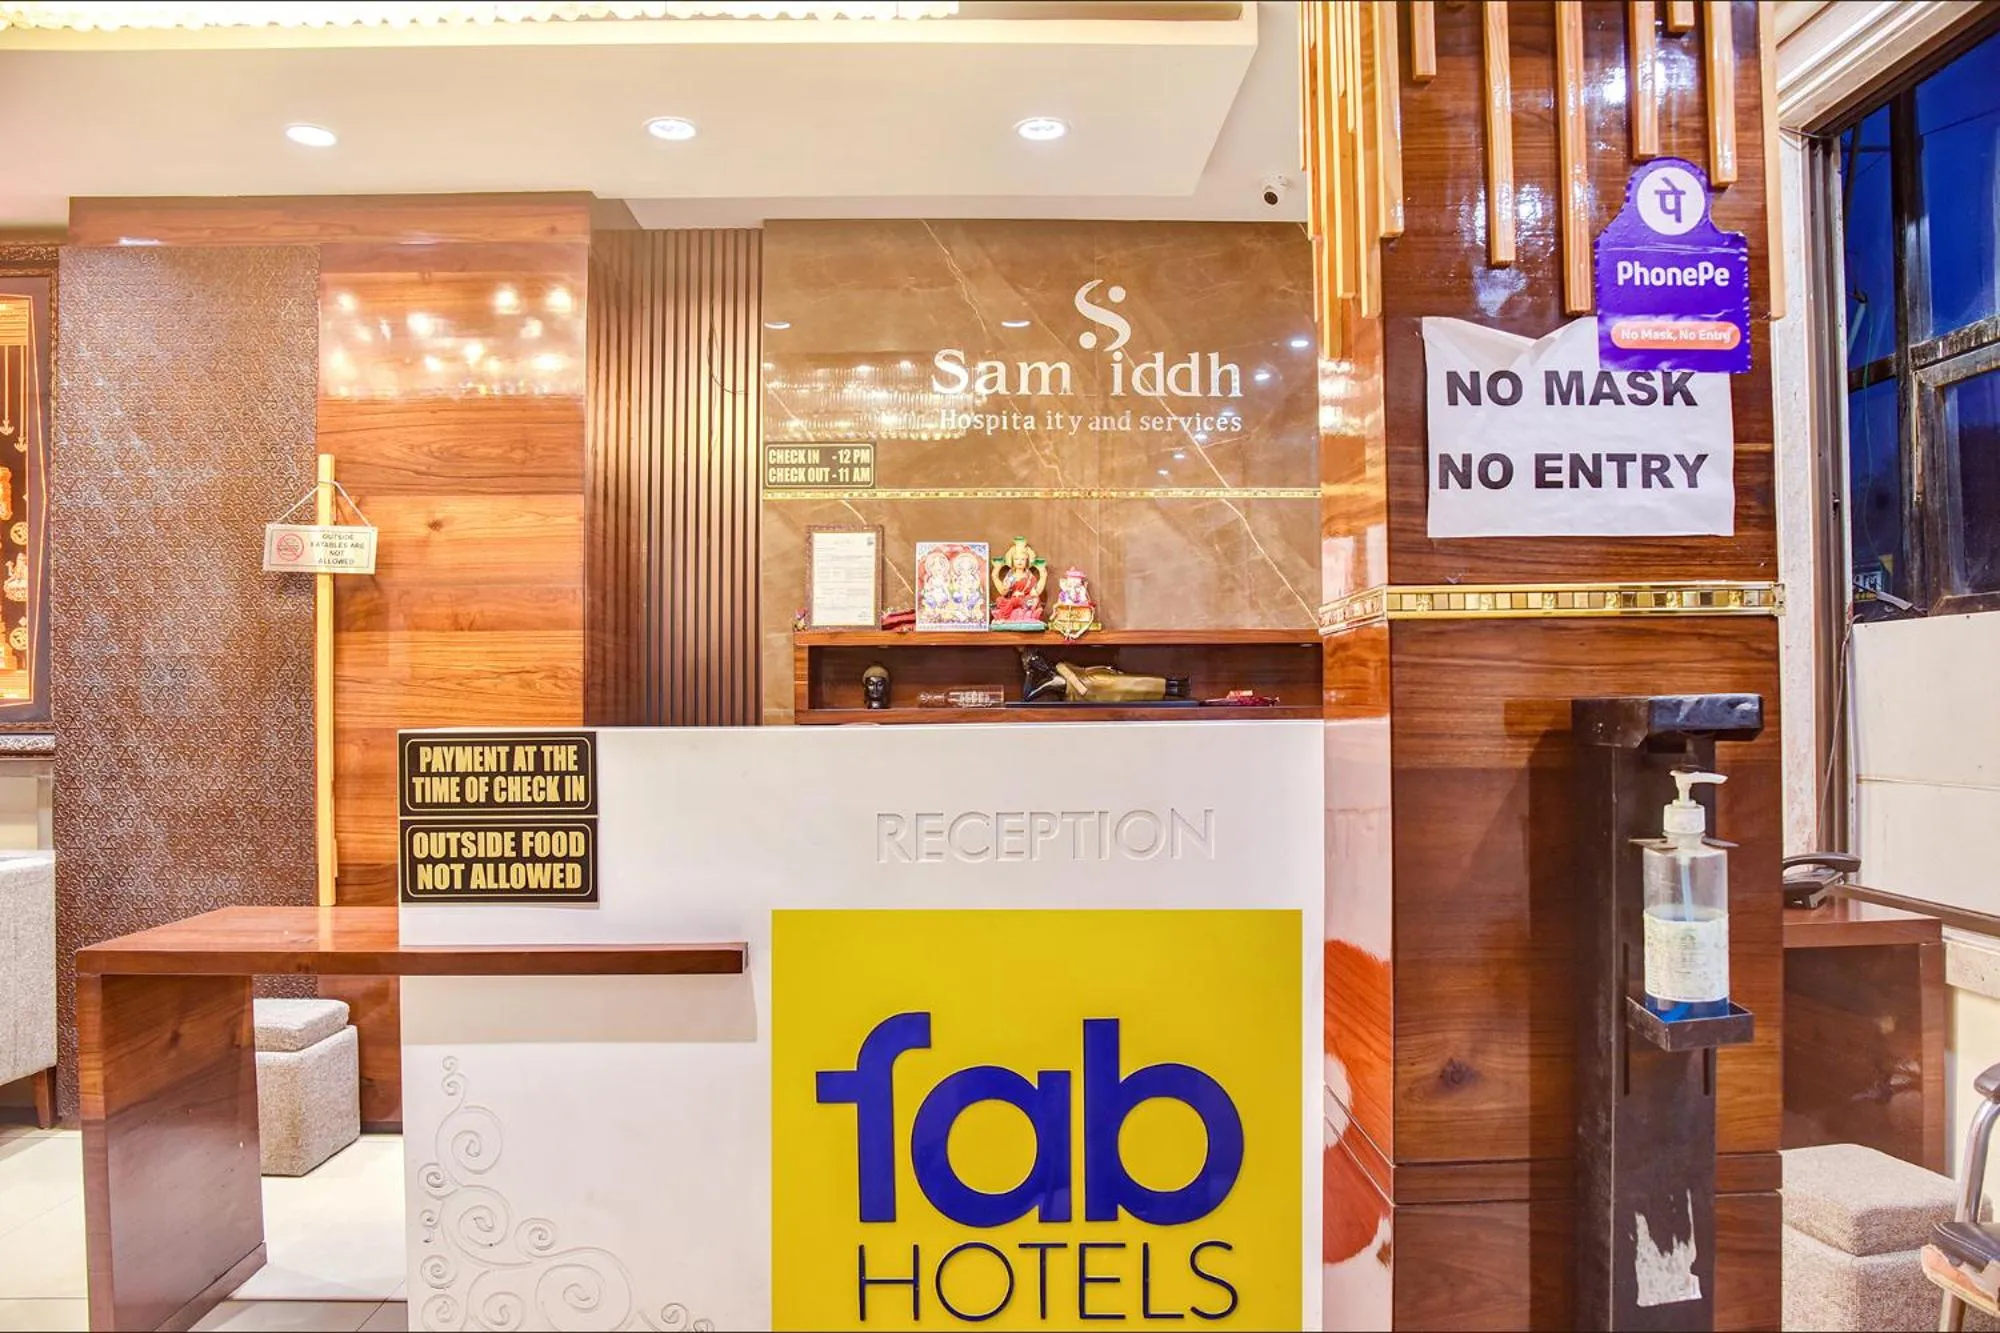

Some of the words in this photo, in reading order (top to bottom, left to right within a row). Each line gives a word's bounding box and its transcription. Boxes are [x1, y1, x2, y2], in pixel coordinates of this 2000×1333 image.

[1654, 177, 1686, 223] पे
[1616, 260, 1731, 287] PhonePe
[1621, 325, 1639, 340] No
[1641, 325, 1677, 343] Mask,
[1679, 325, 1697, 341] No
[1699, 325, 1733, 343] Entry
[1446, 370, 1524, 406] NO
[1544, 370, 1698, 406] MASK
[1088, 410, 1131, 432] and
[1139, 411, 1242, 433] services
[768, 449, 806, 465] CHECK
[807, 449, 820, 465] IN
[853, 449, 871, 465] PM
[768, 467, 806, 483] CHECK
[807, 467, 831, 483] OUT
[852, 467, 871, 482] AM
[1438, 453, 1514, 490] NO
[1534, 453, 1709, 489] ENTRY
[419, 745, 510, 773] PAYMENT
[513, 745, 537, 772] AT
[541, 744, 578, 772] THE
[412, 776, 461, 803] TIME
[464, 776, 489, 803] OF
[493, 775, 561, 803] CHECK
[564, 775, 585, 802] IN
[413, 831, 517, 859] OUTSIDE
[522, 831, 586, 858] FOOD
[876, 808, 1215, 863] RECEPTION
[416, 863, 465, 890] NOT
[470, 862, 582, 890] ALLOWED
[815, 1011, 1245, 1228] fab
[858, 1240, 1238, 1322] HOTELS
